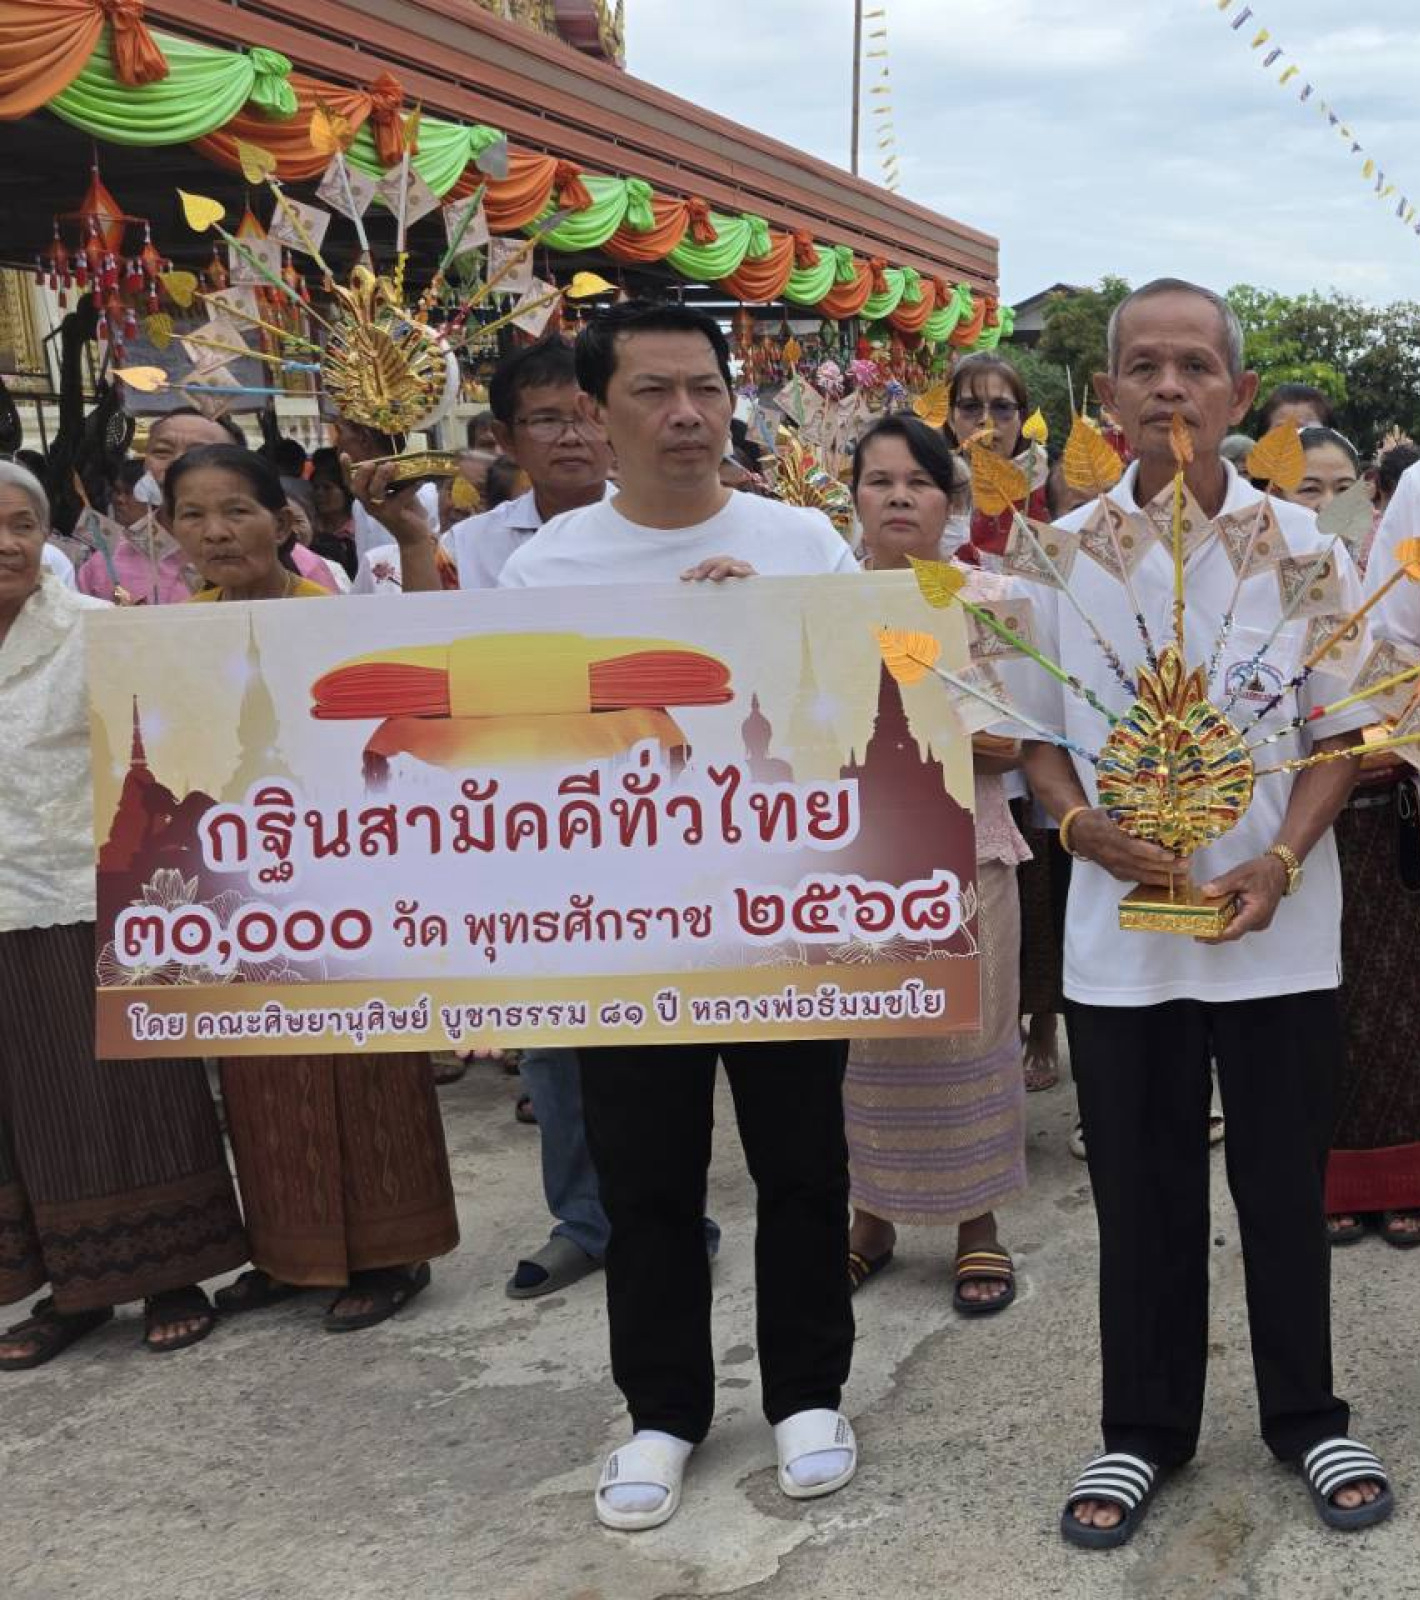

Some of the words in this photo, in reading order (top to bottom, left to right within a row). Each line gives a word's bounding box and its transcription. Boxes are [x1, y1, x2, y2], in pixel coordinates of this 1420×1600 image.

[206, 749, 852, 885] กฐินสามัคคีทั่วไทย
[123, 908, 373, 965] ๓๐,๐๐๐
[392, 900, 449, 948] วัด
[464, 895, 713, 963] พุทธศักราช
[734, 880, 952, 936] ๒๕๖๘
[131, 1006, 185, 1038] โดย
[198, 998, 430, 1042] คณะศิษยานุศิษย์
[441, 1002, 587, 1039] บูชาธรรม
[600, 1000, 644, 1025] ๘๑
[657, 989, 680, 1022] ปี
[692, 984, 944, 1020] หลวงพ่อธัมมชโย
